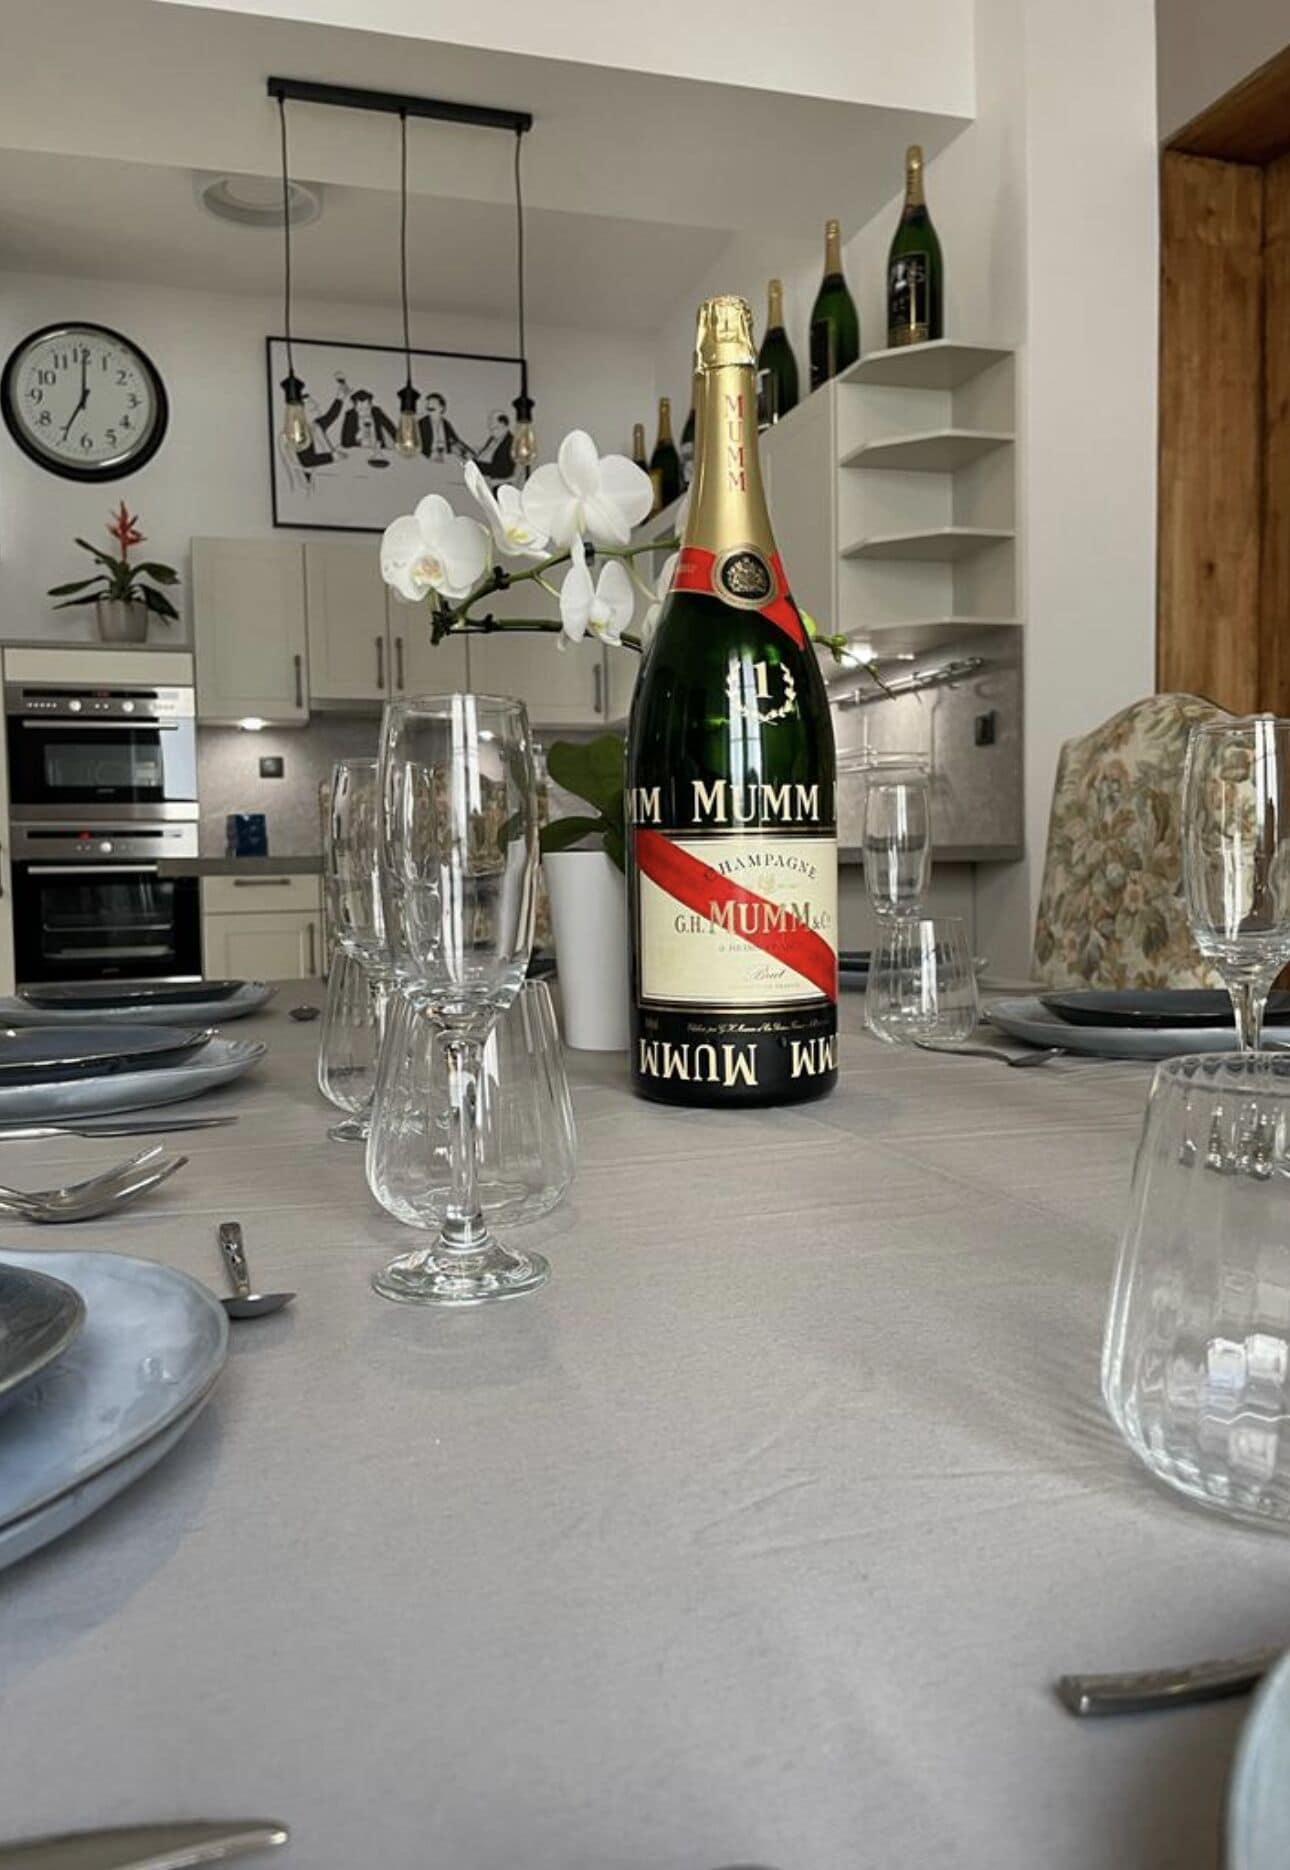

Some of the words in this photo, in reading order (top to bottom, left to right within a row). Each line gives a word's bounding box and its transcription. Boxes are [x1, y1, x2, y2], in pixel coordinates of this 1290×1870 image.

[53, 353, 69, 370] 11
[73, 348, 91, 365] 12
[102, 355, 109, 372] 1
[38, 369, 57, 386] 10
[116, 369, 128, 386] 2
[30, 387, 43, 405] 9
[127, 393, 138, 409] 3
[39, 410, 52, 426] 8
[119, 414, 131, 429] 4
[80, 433, 93, 449] 6
[105, 428, 117, 449] 5
[726, 393, 746, 492] MUMM
[753, 661, 773, 700] 1
[691, 779, 820, 823] MUMM
[704, 853, 817, 880] CHAMPAGNE
[674, 914, 705, 935] G.H.
[709, 900, 814, 936] MUMM
[639, 1038, 759, 1087] MUMM
